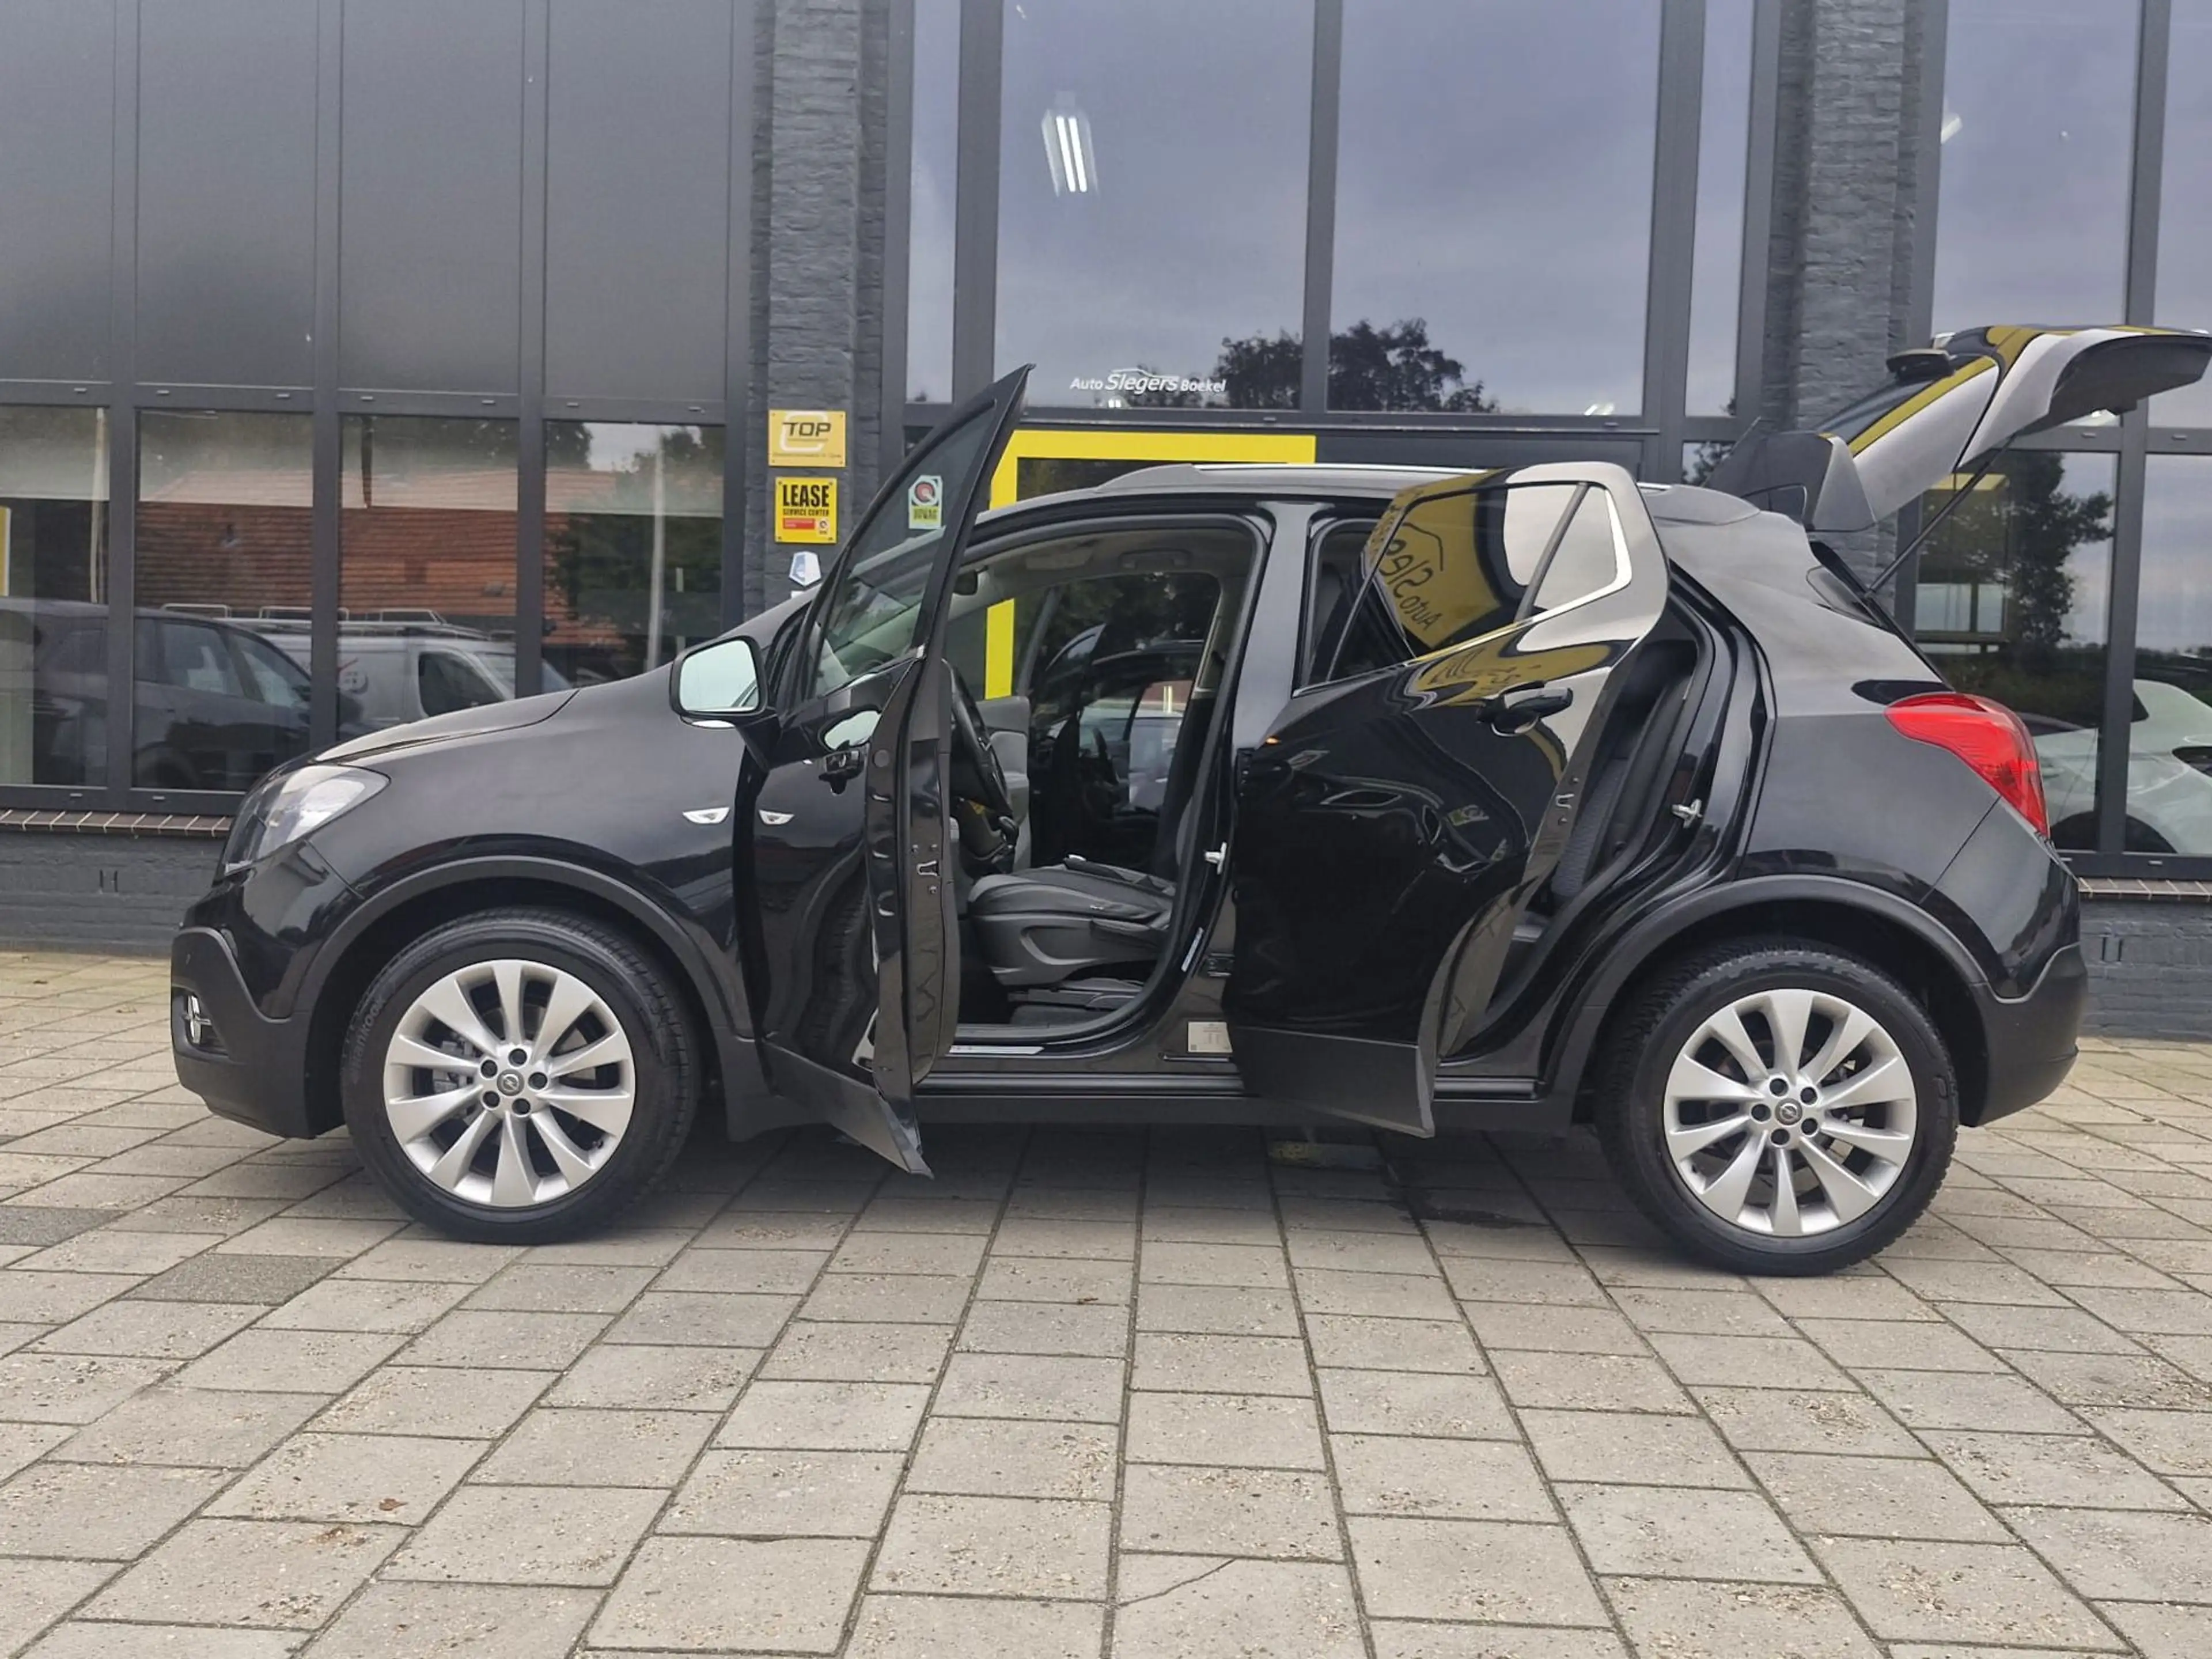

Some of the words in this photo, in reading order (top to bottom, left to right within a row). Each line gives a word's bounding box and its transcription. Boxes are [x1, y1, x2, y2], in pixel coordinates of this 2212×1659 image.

[1069, 377, 1104, 390] Auto
[1104, 373, 1179, 395] Slegers
[1180, 378, 1227, 392] Boekel
[782, 422, 831, 437] TOP
[782, 484, 830, 507] LEASE
[782, 508, 806, 517] SERVICE
[808, 508, 830, 517] CENTER
